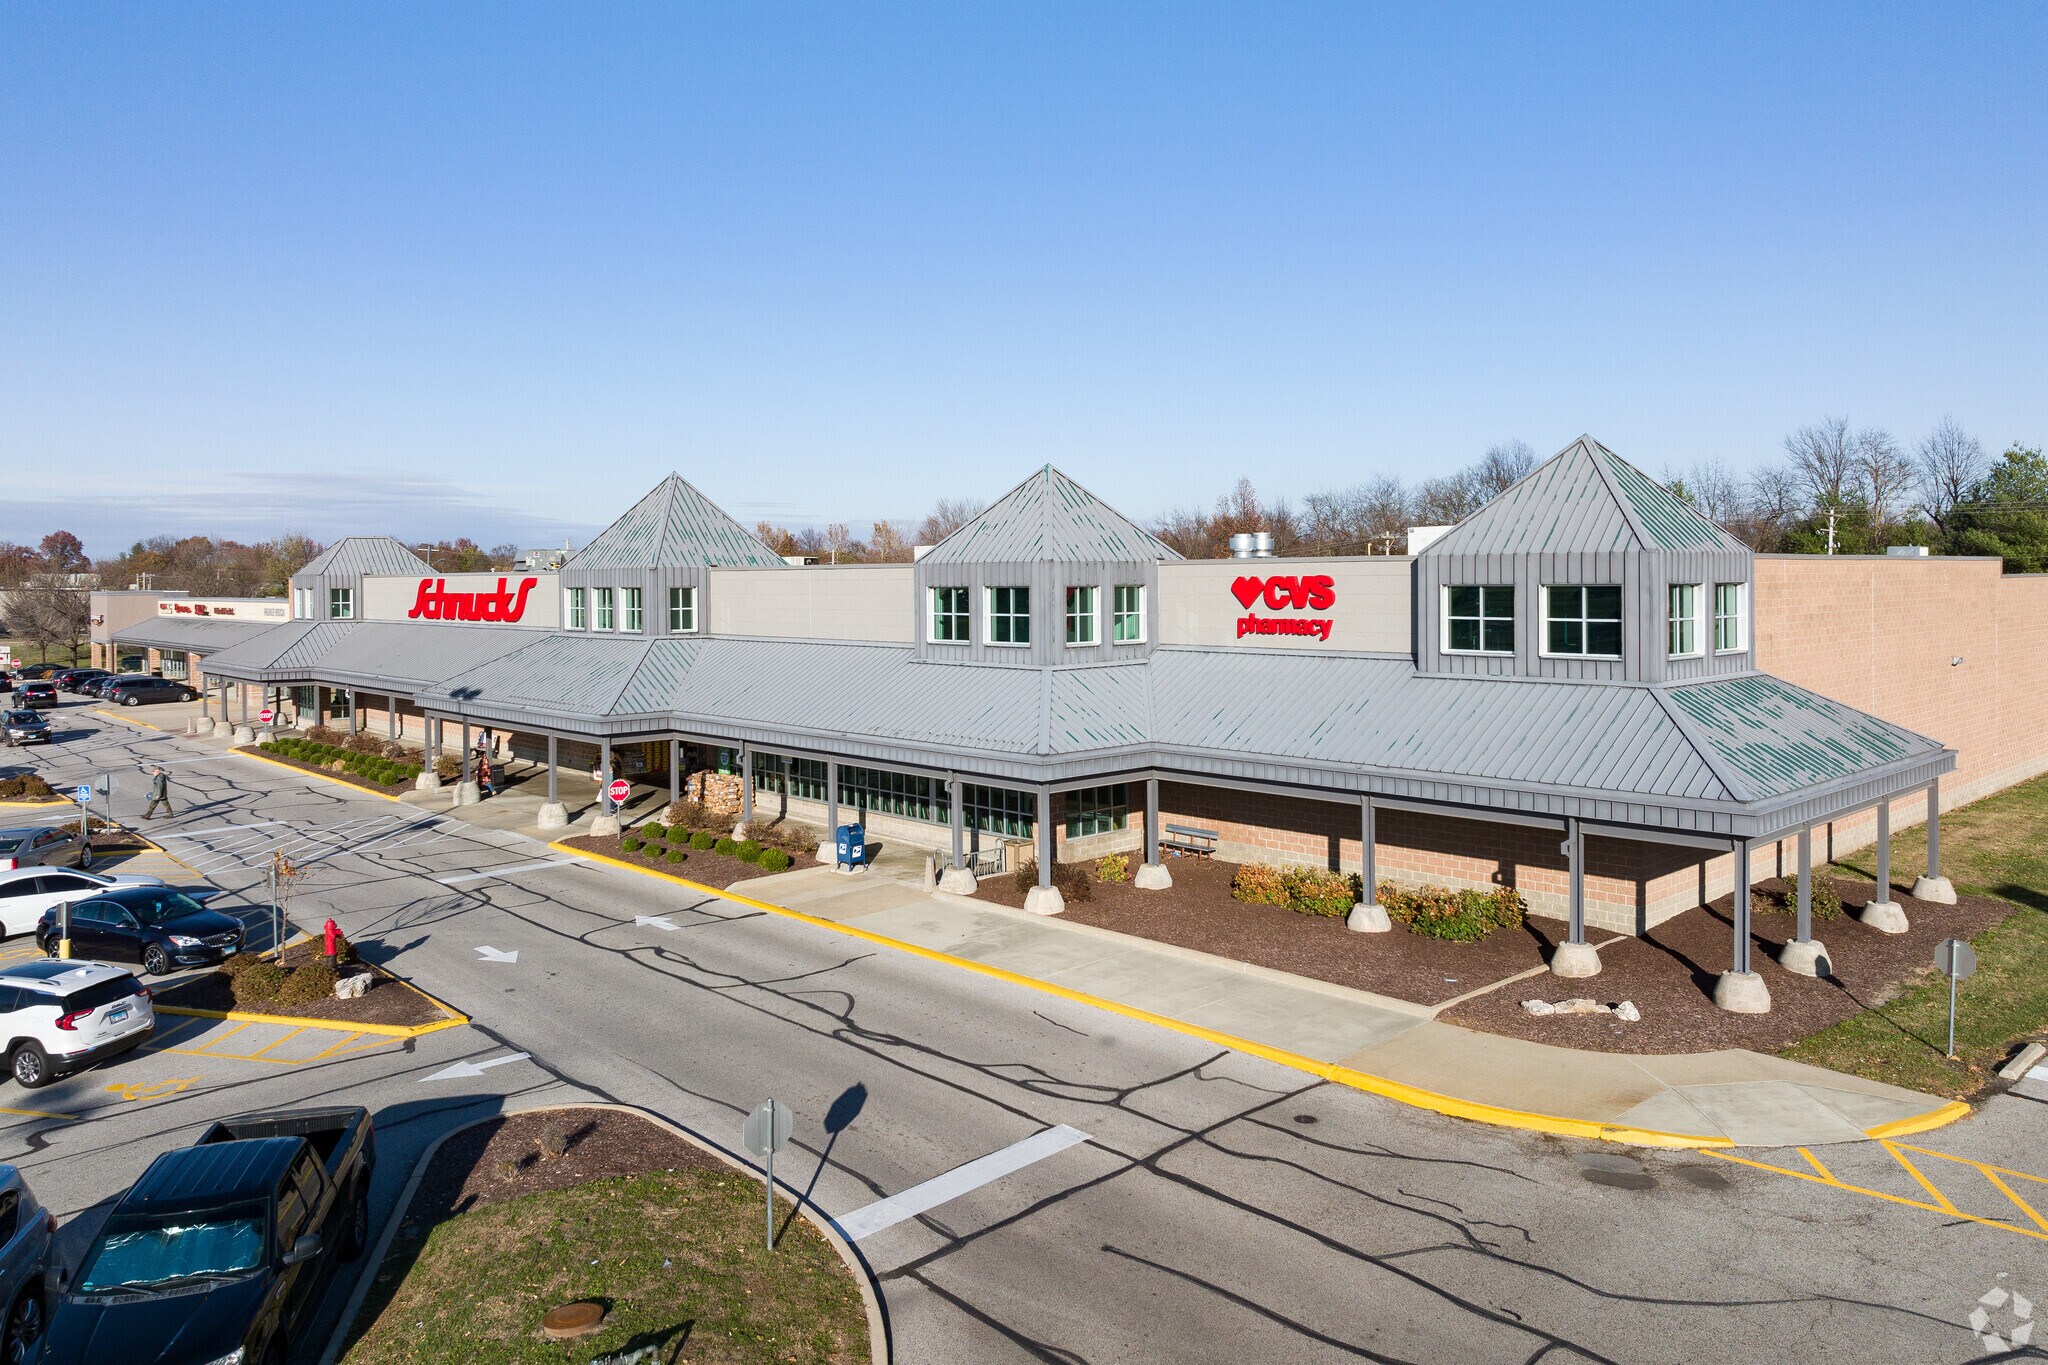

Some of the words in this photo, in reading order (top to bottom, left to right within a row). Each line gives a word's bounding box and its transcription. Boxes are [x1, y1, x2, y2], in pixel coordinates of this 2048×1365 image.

[1263, 575, 1336, 610] CVS
[1237, 613, 1334, 641] pharmacy
[610, 786, 628, 796] STOP
